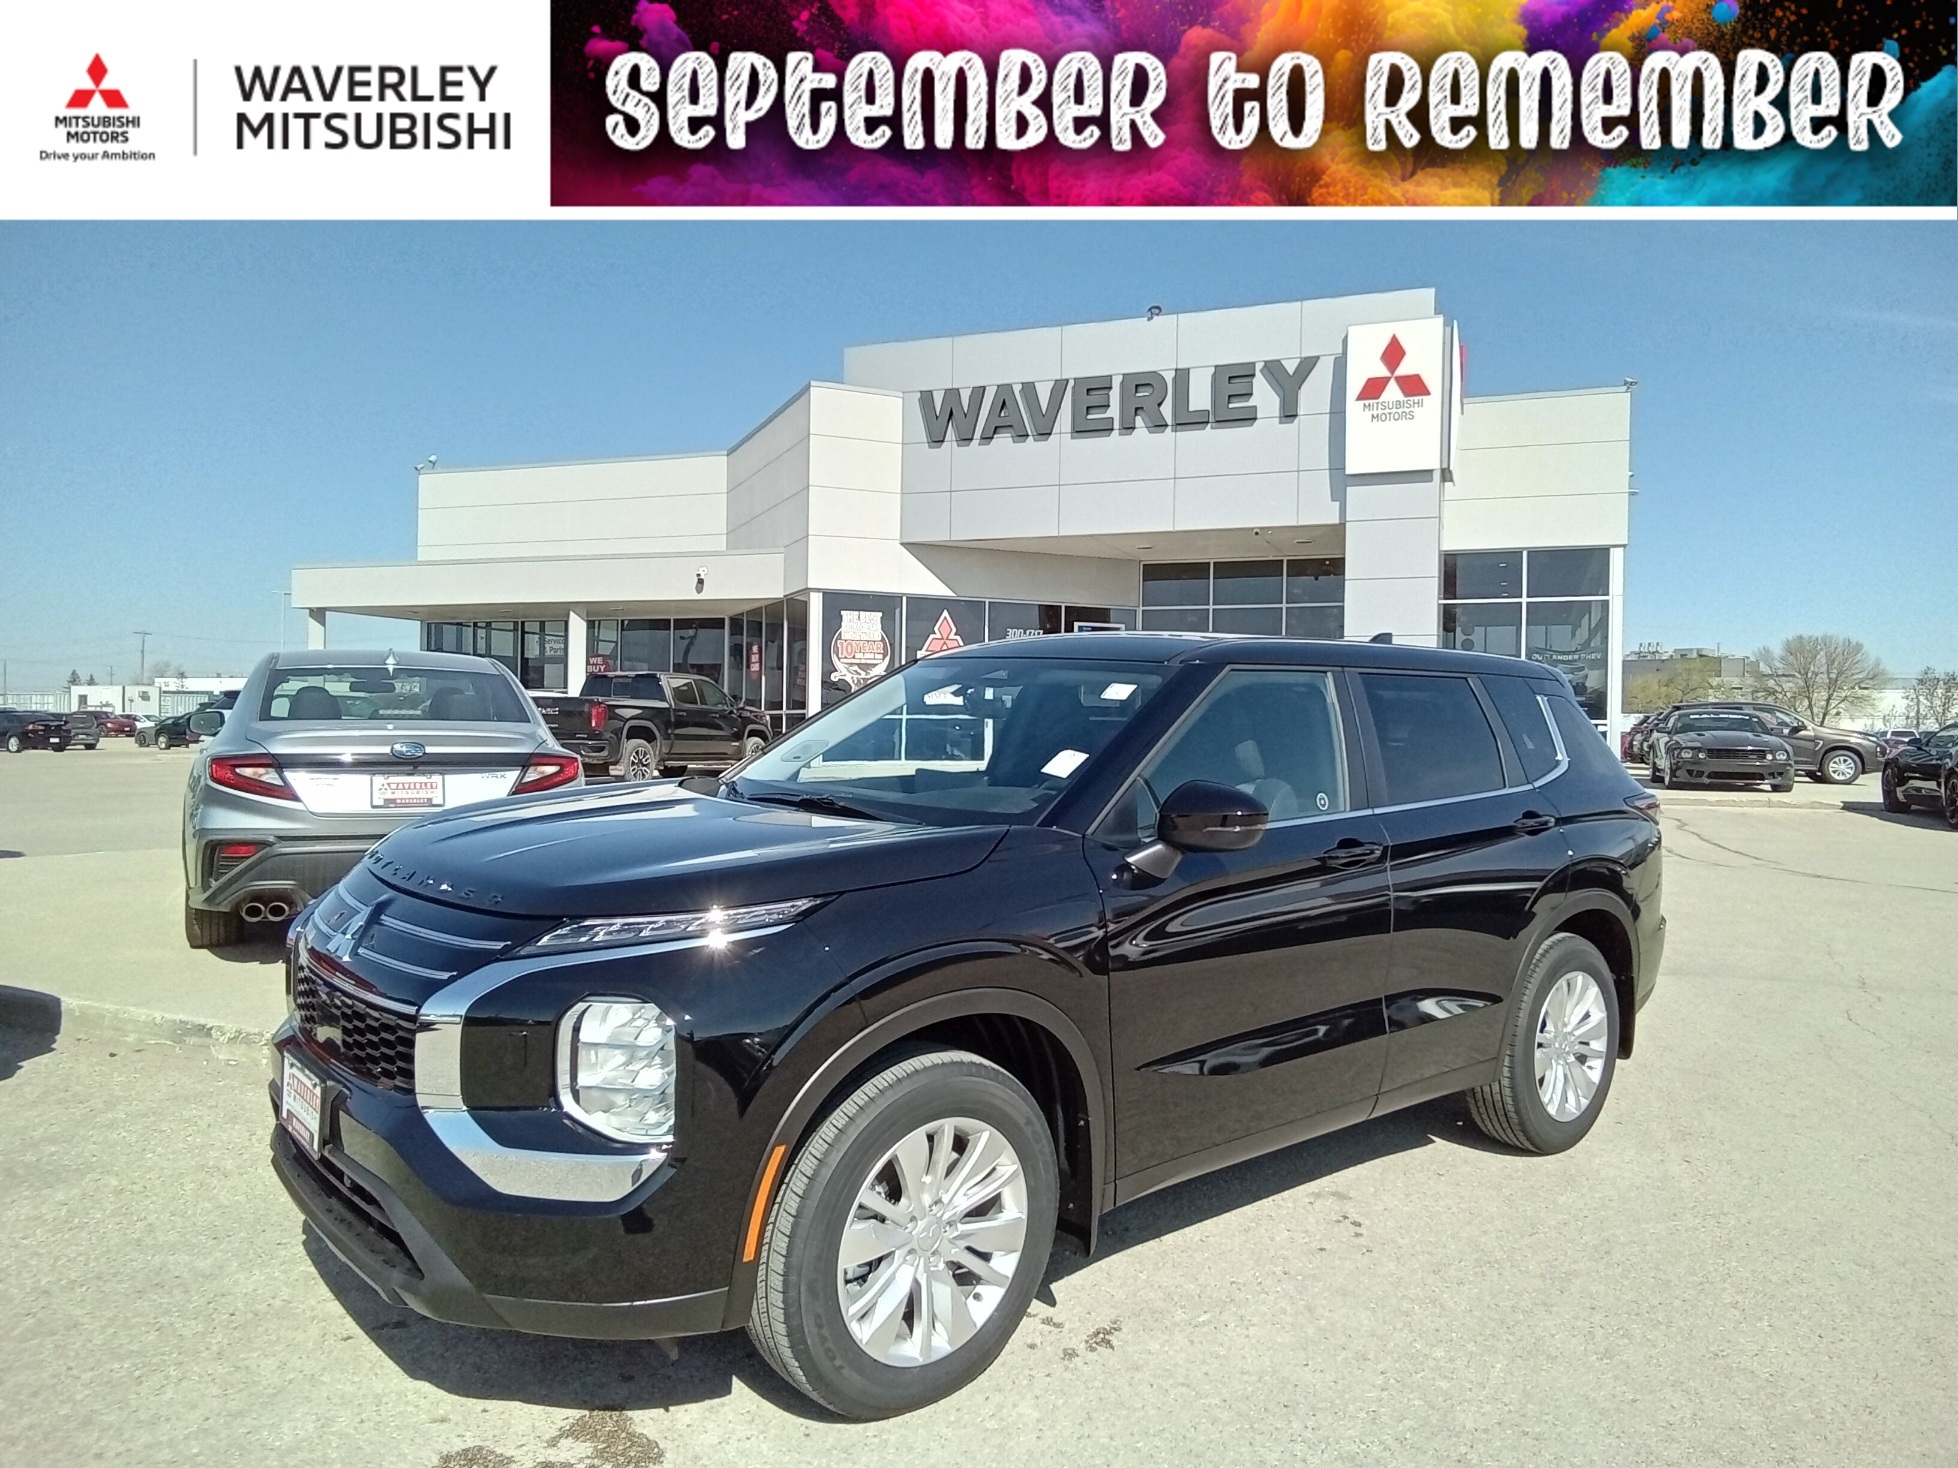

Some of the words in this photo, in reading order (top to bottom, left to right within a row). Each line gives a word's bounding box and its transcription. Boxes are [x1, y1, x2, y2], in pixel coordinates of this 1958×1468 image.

[919, 356, 1320, 445] WAVERLEY
[1363, 399, 1424, 412] MITSUBISHI
[1371, 411, 1415, 423] MOTORS
[838, 641, 855, 658] 10
[855, 642, 883, 652] YEAR
[589, 656, 604, 664] WE
[586, 665, 606, 673] BUY
